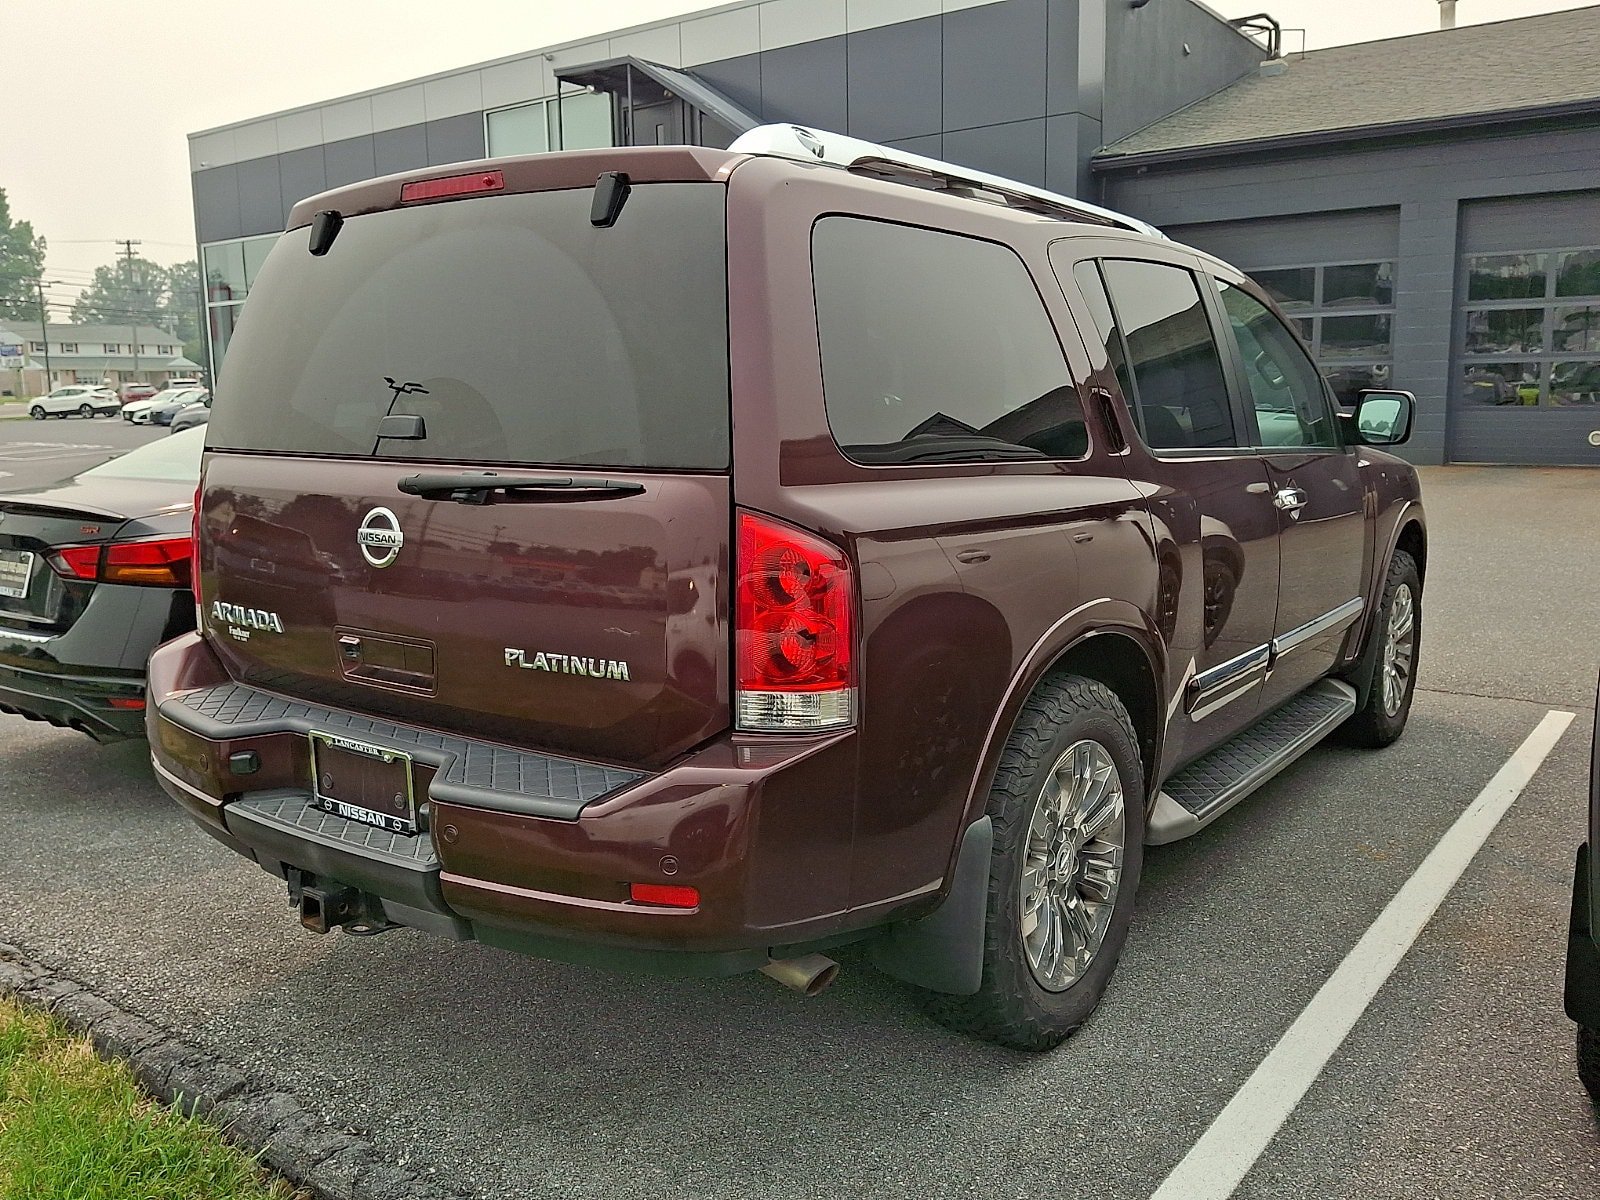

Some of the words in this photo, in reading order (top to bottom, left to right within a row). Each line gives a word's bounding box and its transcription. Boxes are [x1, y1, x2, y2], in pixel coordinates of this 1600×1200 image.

[81, 525, 100, 534] SR
[360, 532, 396, 544] NISSAN
[211, 600, 285, 634] ARMADA
[504, 647, 631, 681] PLATINUM
[335, 738, 380, 756] LANCASTER
[338, 803, 386, 828] NISSAN
